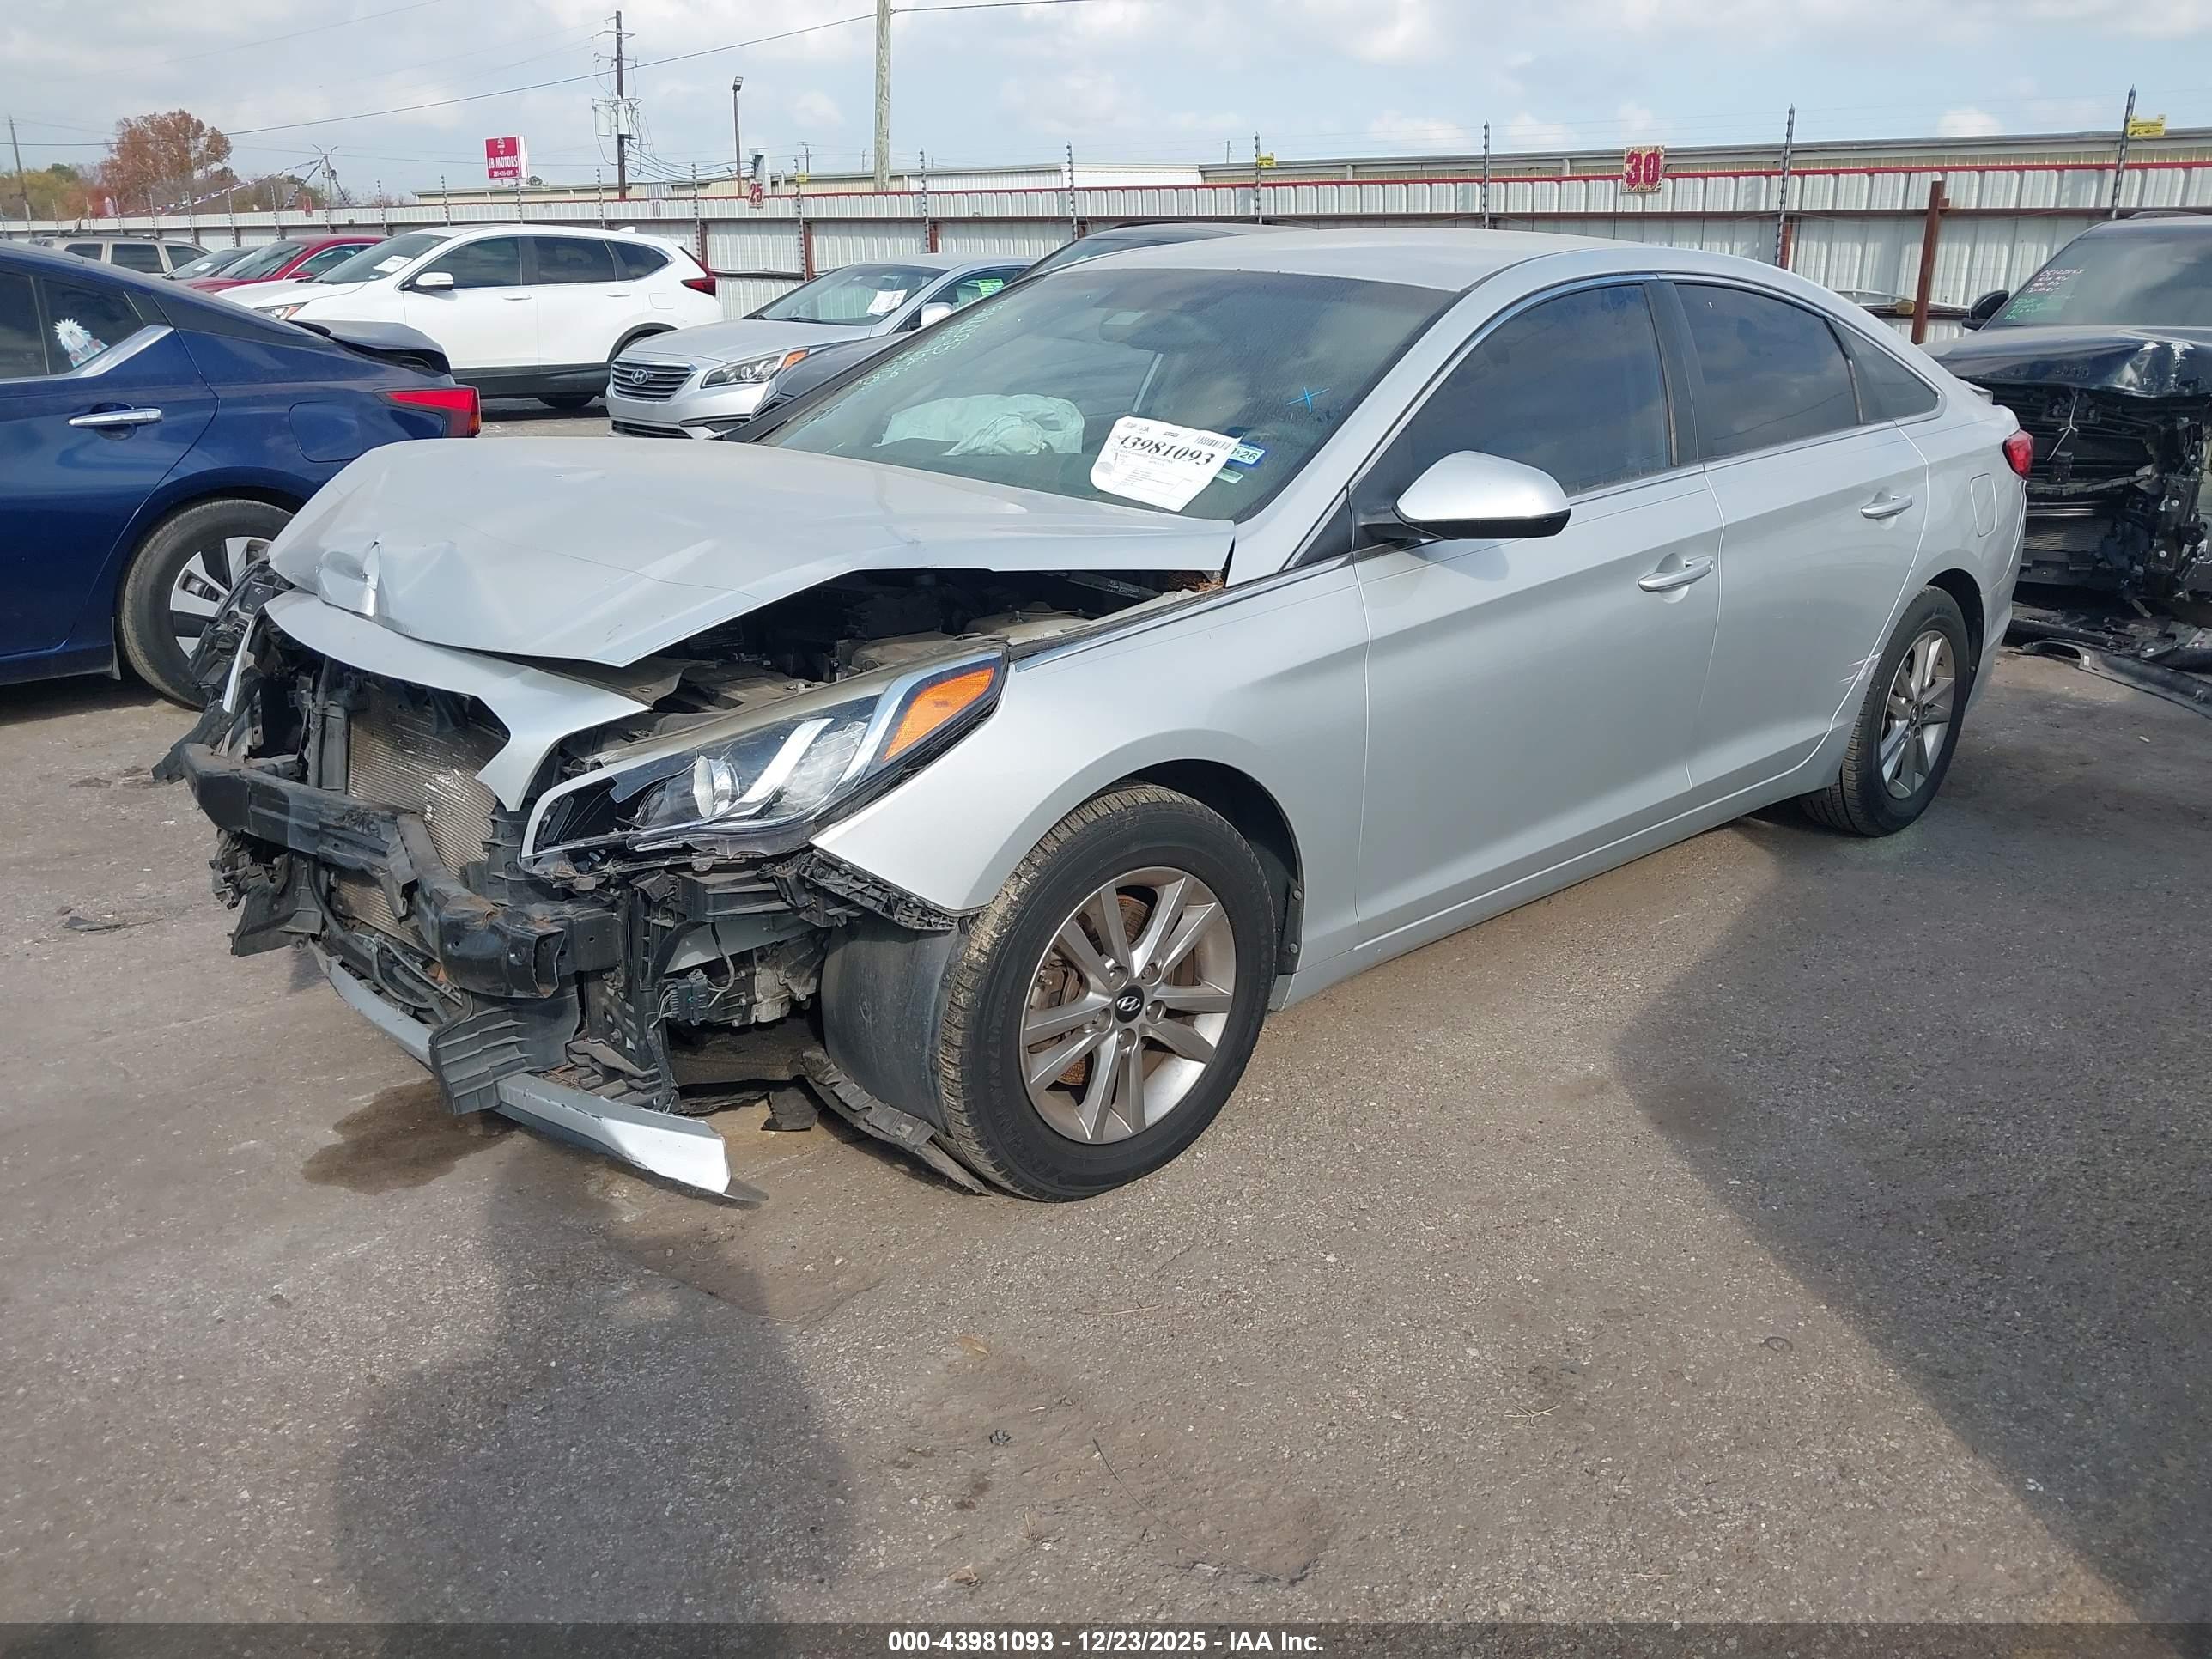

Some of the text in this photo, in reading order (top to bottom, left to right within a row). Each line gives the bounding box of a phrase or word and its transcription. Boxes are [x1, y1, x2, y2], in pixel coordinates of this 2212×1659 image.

[495, 155, 518, 168] MOTORS
[1626, 150, 1660, 186] 30
[749, 183, 763, 203] 25
[651, 201, 661, 218] 10
